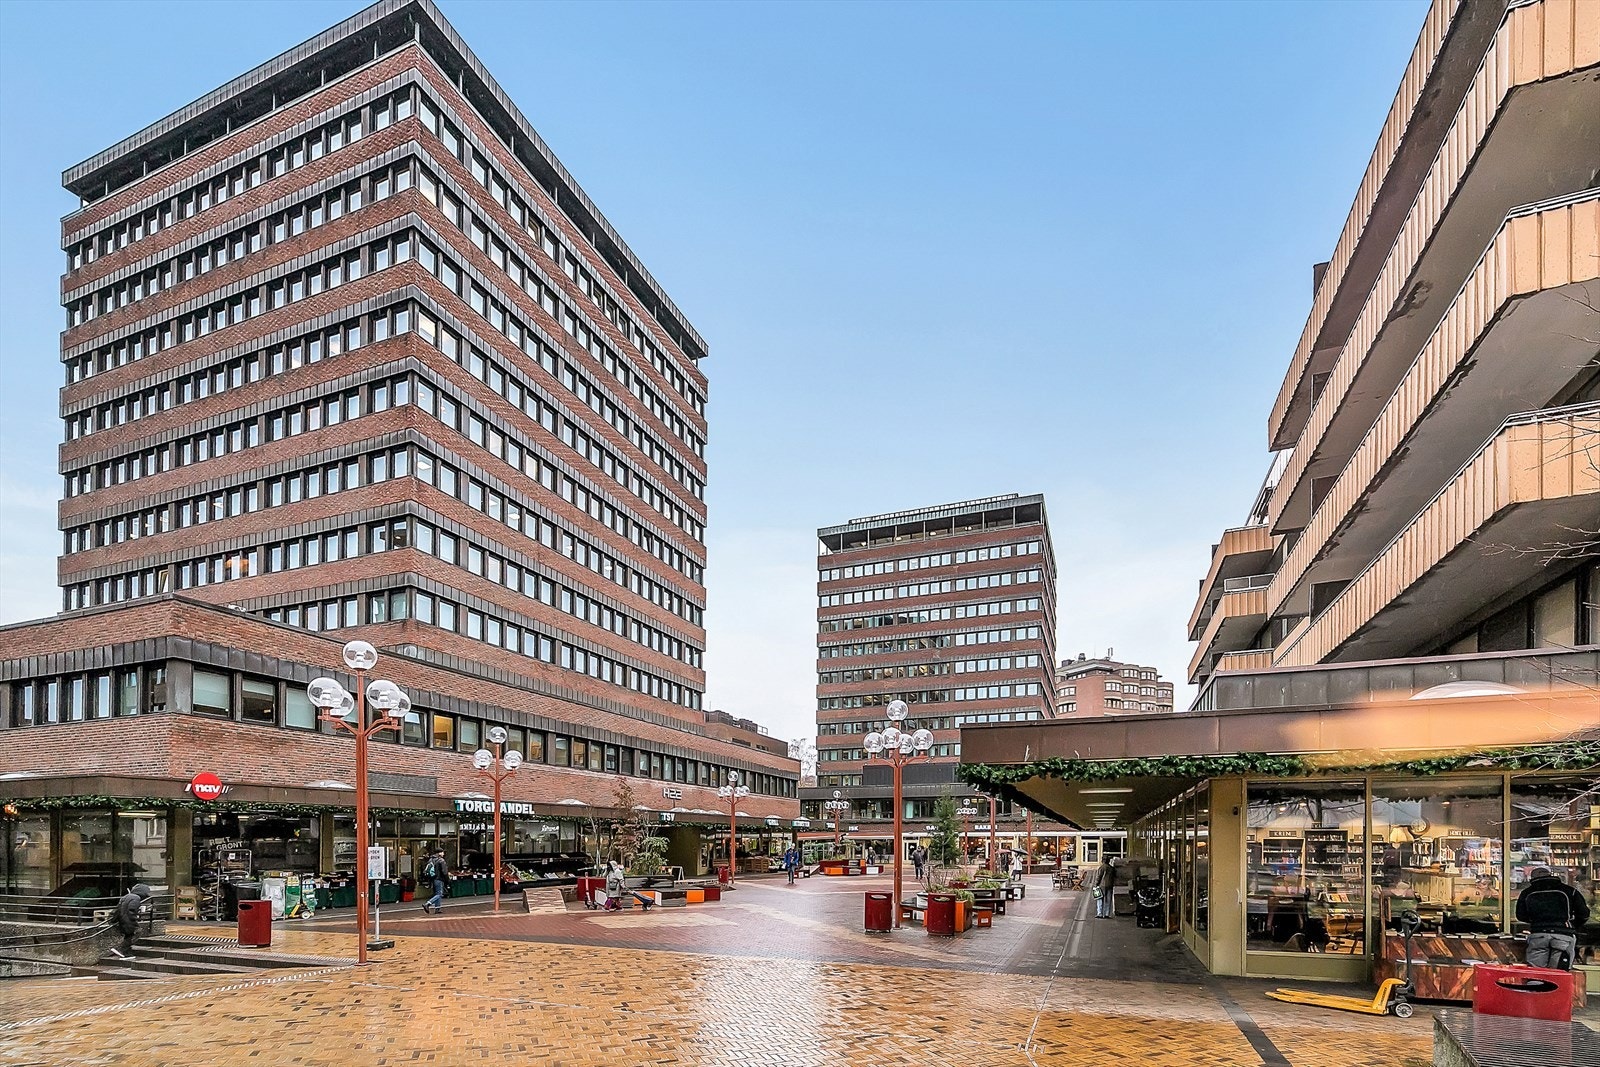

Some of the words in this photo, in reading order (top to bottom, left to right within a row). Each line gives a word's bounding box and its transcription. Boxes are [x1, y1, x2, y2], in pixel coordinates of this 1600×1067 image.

[195, 784, 220, 793] nav
[663, 788, 682, 800] H22
[661, 813, 676, 821] TSV
